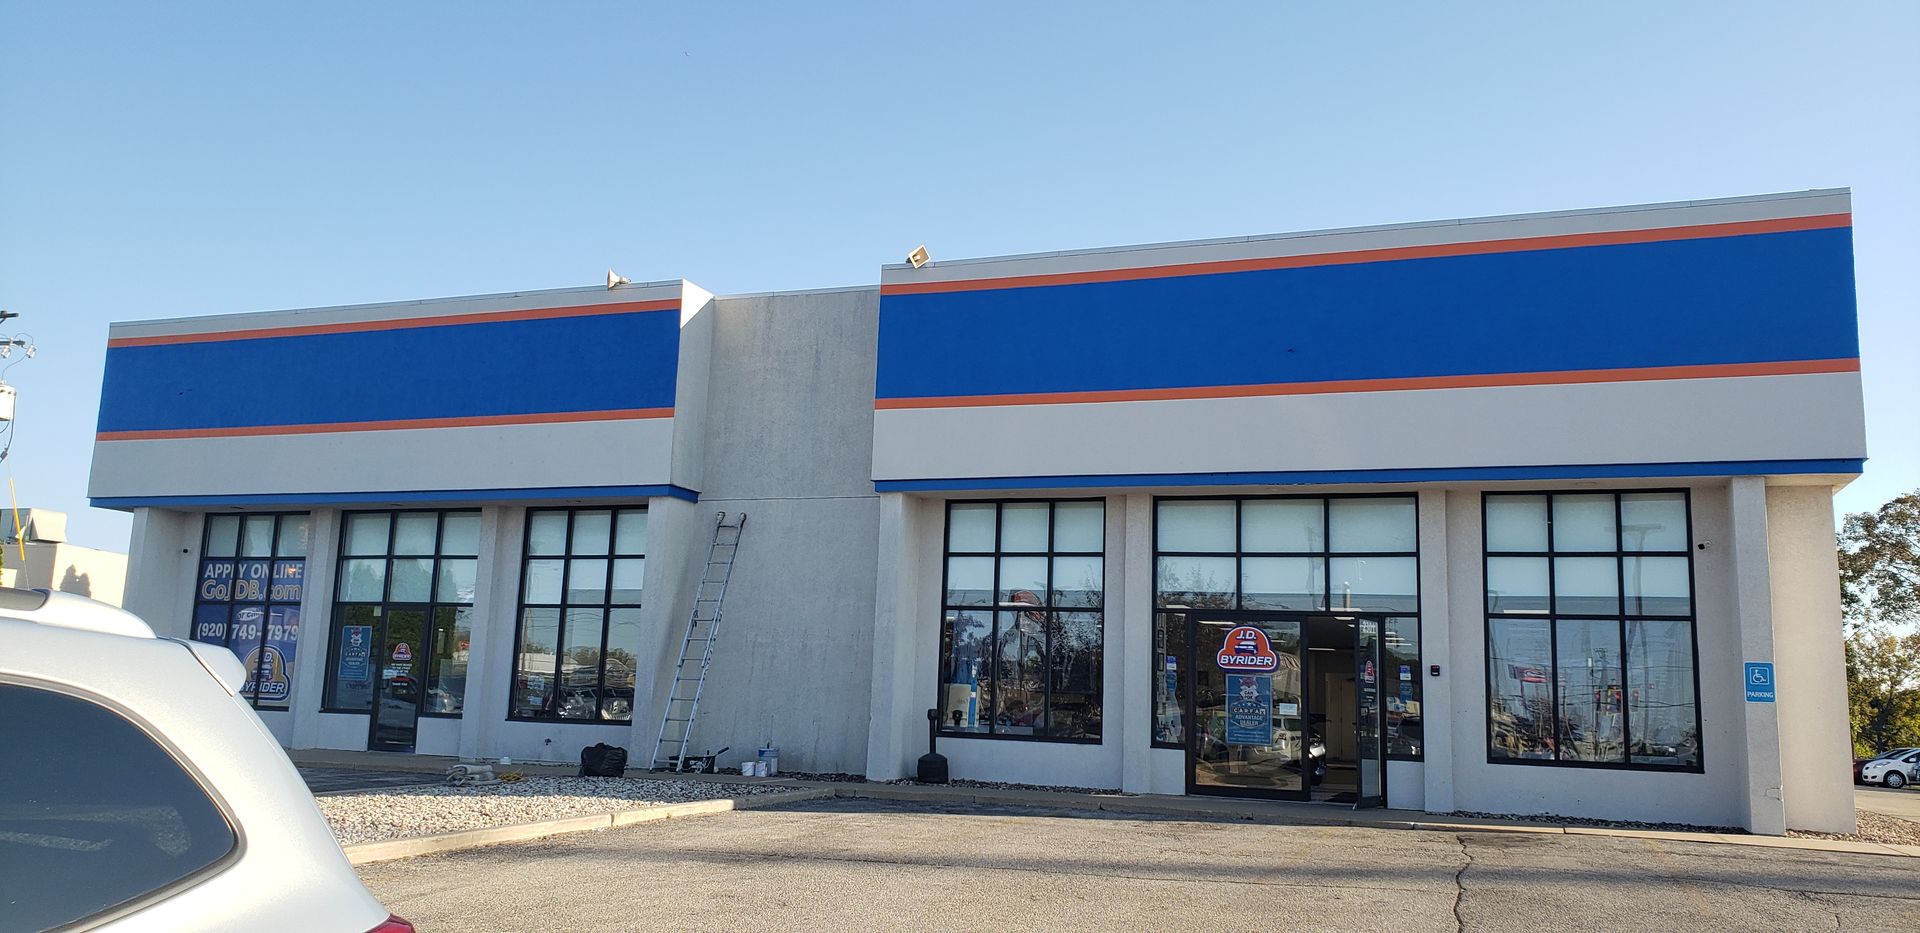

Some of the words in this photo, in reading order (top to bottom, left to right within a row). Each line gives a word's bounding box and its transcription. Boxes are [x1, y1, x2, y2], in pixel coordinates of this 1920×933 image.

[250, 563, 303, 579] ONLINE
[197, 622, 227, 640] (920)
[1236, 630, 1257, 640] J.D.
[1220, 655, 1273, 666] BYRIDER
